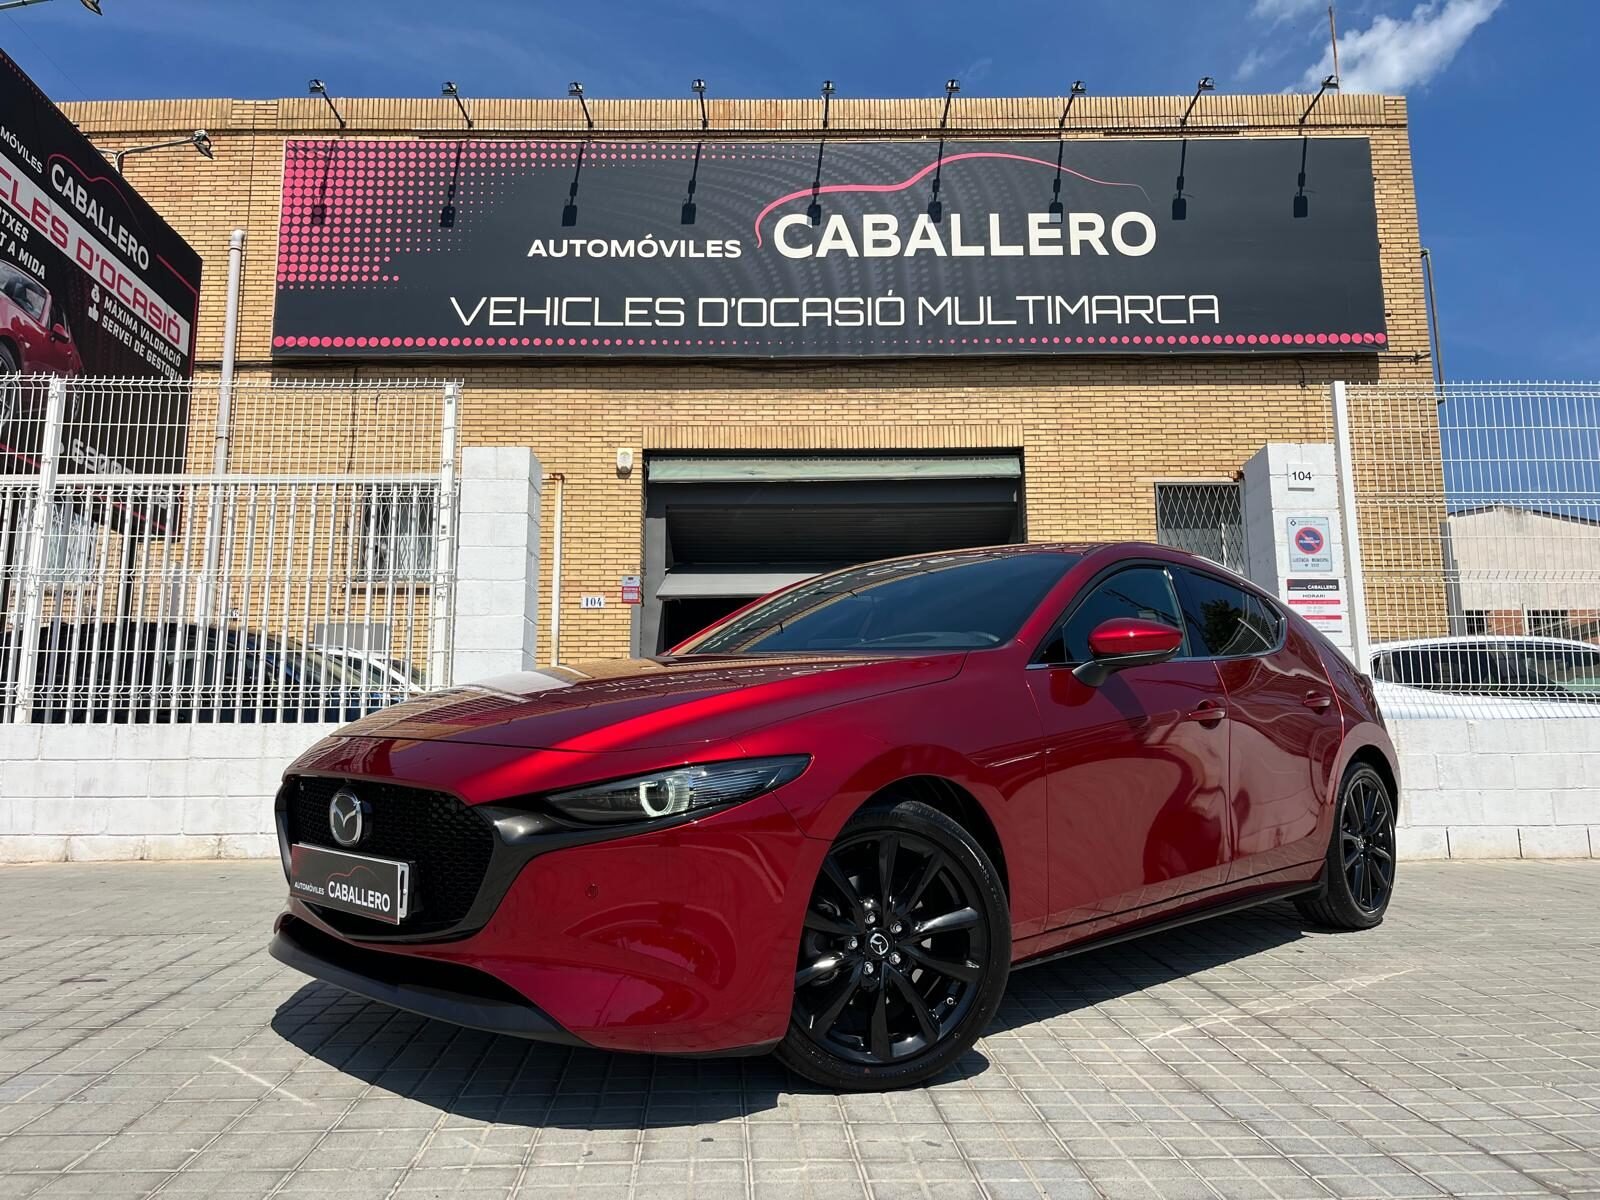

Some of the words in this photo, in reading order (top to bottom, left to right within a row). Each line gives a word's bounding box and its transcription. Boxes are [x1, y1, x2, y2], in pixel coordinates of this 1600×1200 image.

[0, 206, 29, 242] TXES
[51, 163, 149, 271] CABALLERO
[527, 233, 742, 258] AUTOMÓVILES
[773, 210, 1157, 259] CABALLERO
[7, 240, 16, 257] A
[18, 247, 46, 280] MIDA
[76, 236, 180, 345] D'OCASIÓ
[449, 296, 685, 327] VEHICLES
[698, 289, 905, 327] D'OCASIÓ
[918, 294, 1220, 326] MULTIMARCA
[101, 314, 133, 347] SERVEI
[133, 340, 145, 357] DE
[140, 325, 181, 367] VALORACIÓ
[1291, 471, 1312, 481] 104
[585, 597, 602, 607] 104
[294, 881, 325, 896] AUTOMÓVILES
[328, 880, 391, 912] CABALLERO
